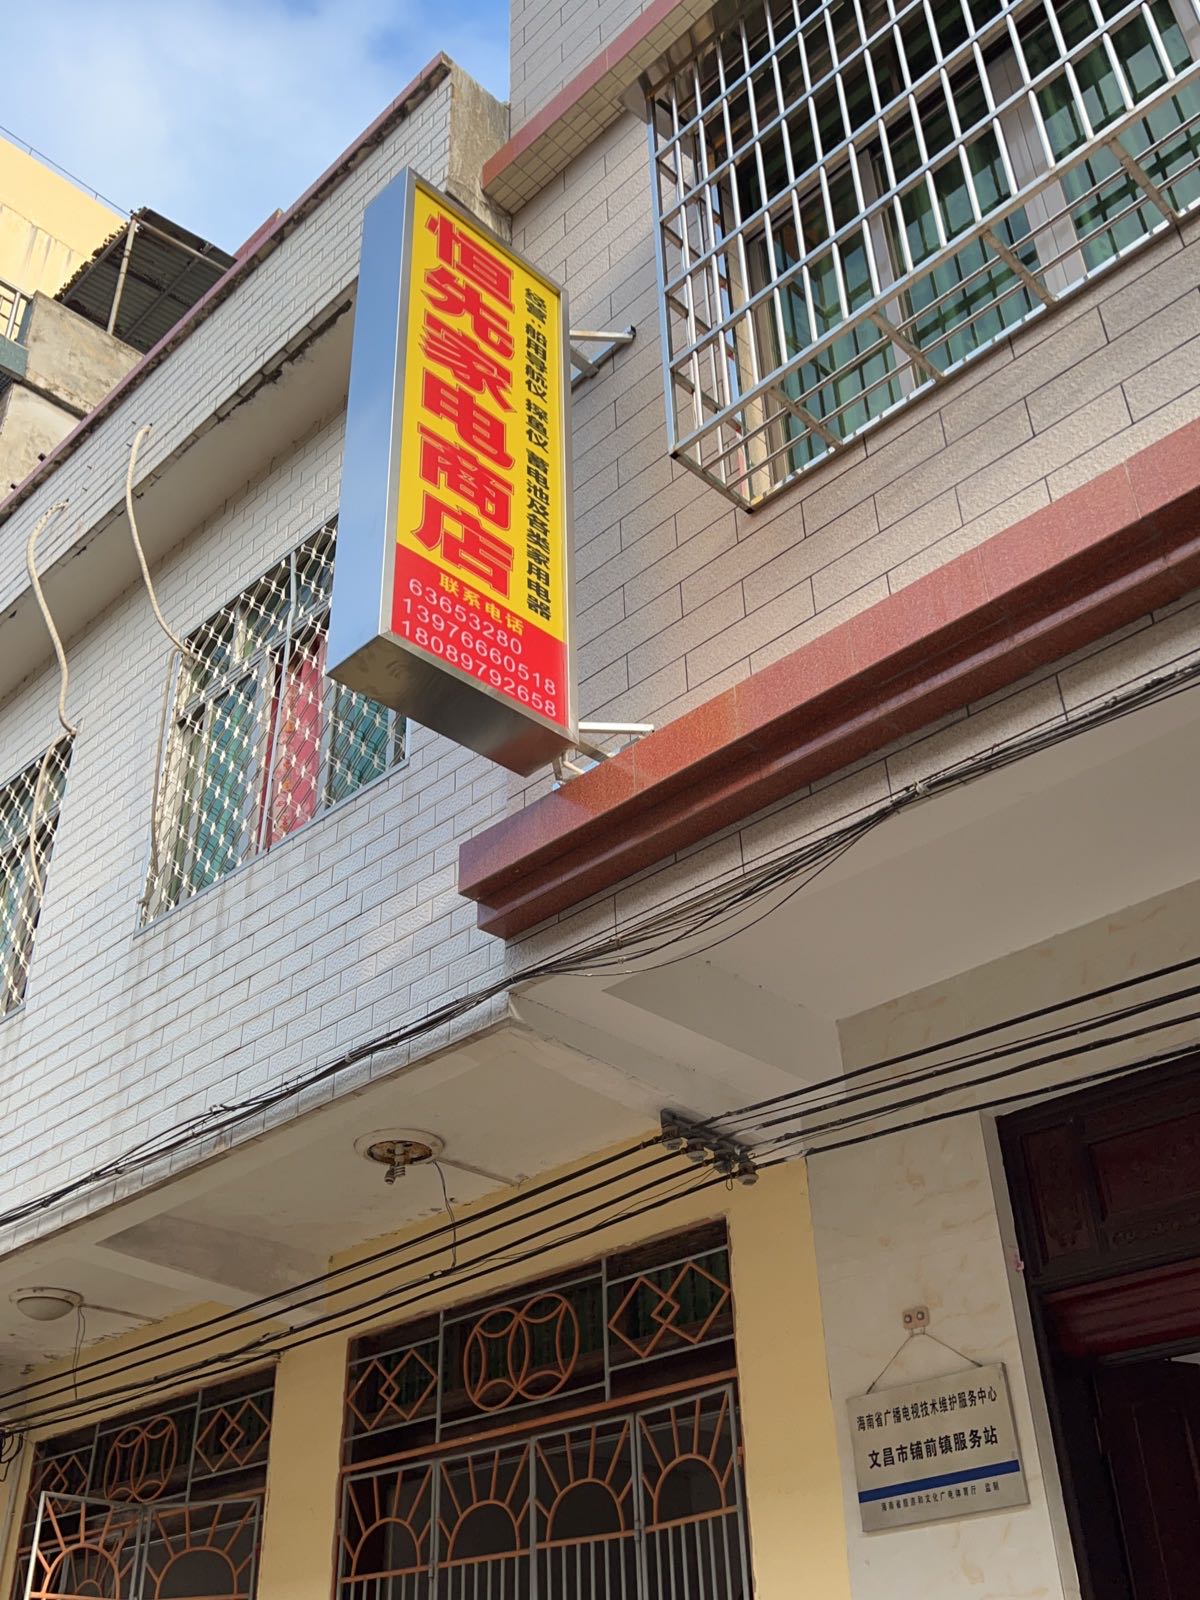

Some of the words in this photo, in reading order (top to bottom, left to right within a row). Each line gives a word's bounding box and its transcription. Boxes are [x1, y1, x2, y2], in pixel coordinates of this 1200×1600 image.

[411, 212, 517, 600] 恒先家电商店
[525, 397, 549, 453] 探鱼仪
[526, 447, 552, 621] 蓄电池及各类家用电器
[409, 578, 522, 655] 63653280
[439, 572, 524, 636] 联系电话
[402, 598, 556, 696] 13976660518
[402, 620, 556, 717] 18089792658
[856, 1386, 997, 1432] 海南省广播电视技术维护服务中心
[868, 1425, 998, 1469] 文昌市铺前镇服务站
